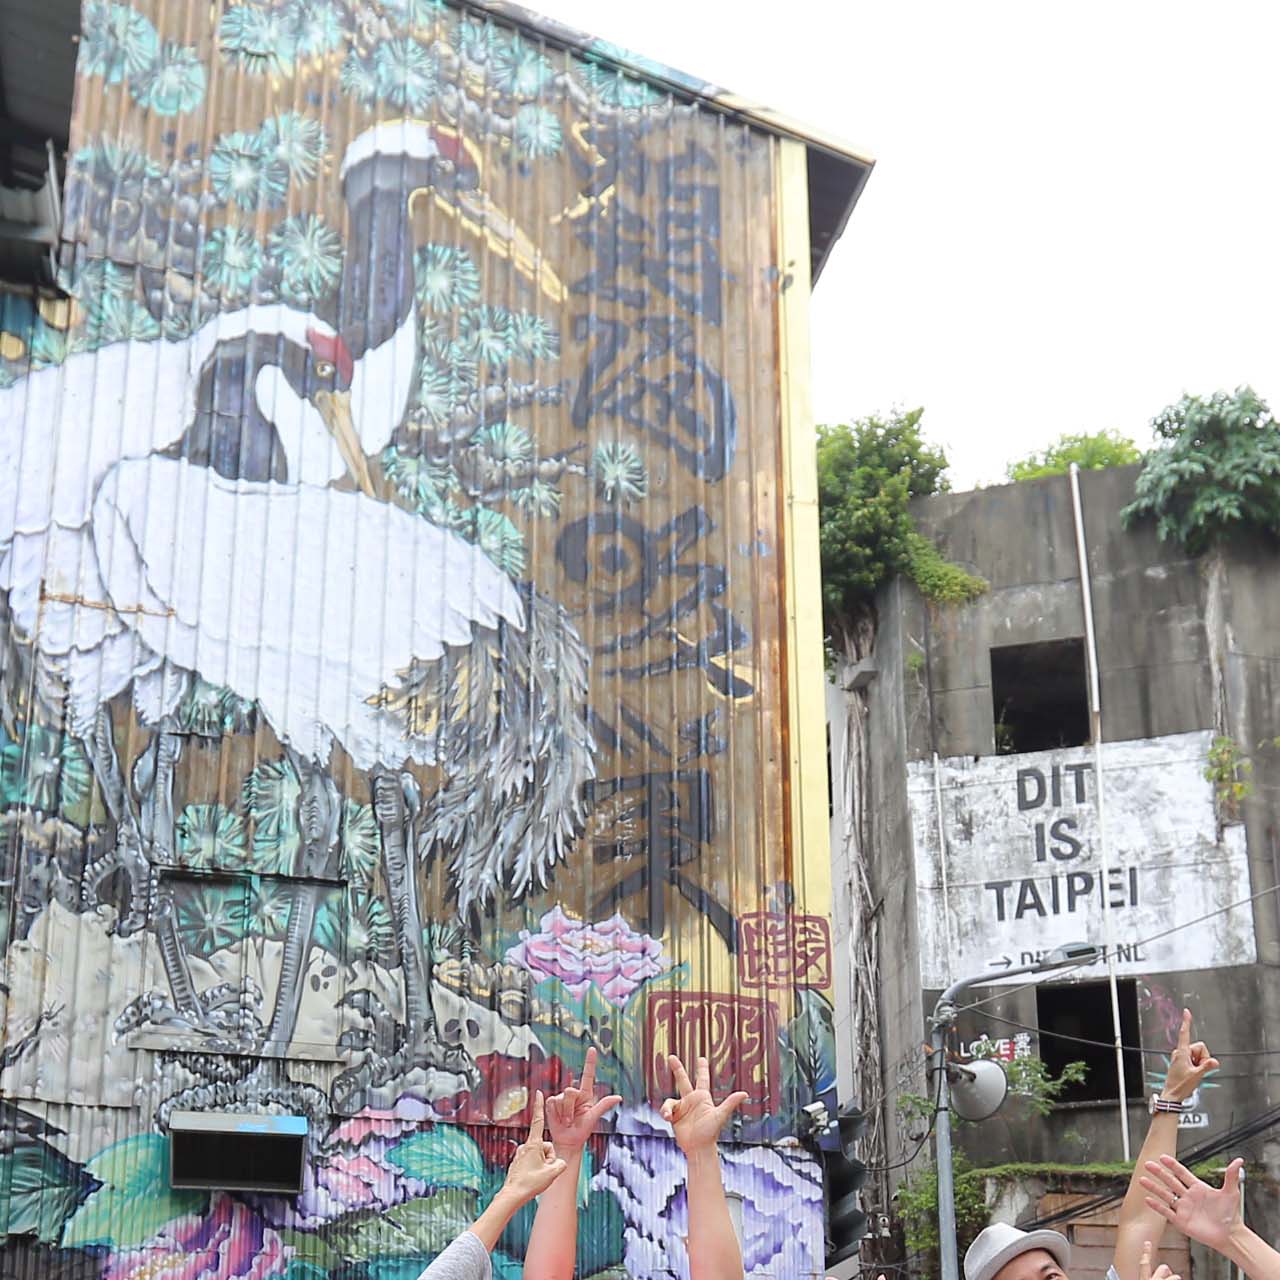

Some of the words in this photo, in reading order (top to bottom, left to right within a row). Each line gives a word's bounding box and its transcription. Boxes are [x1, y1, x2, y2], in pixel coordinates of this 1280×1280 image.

[1016, 762, 1096, 811] DIT
[1034, 817, 1082, 862] IS
[984, 866, 1139, 922] TAIPEI
[1177, 1112, 1203, 1125] AD
